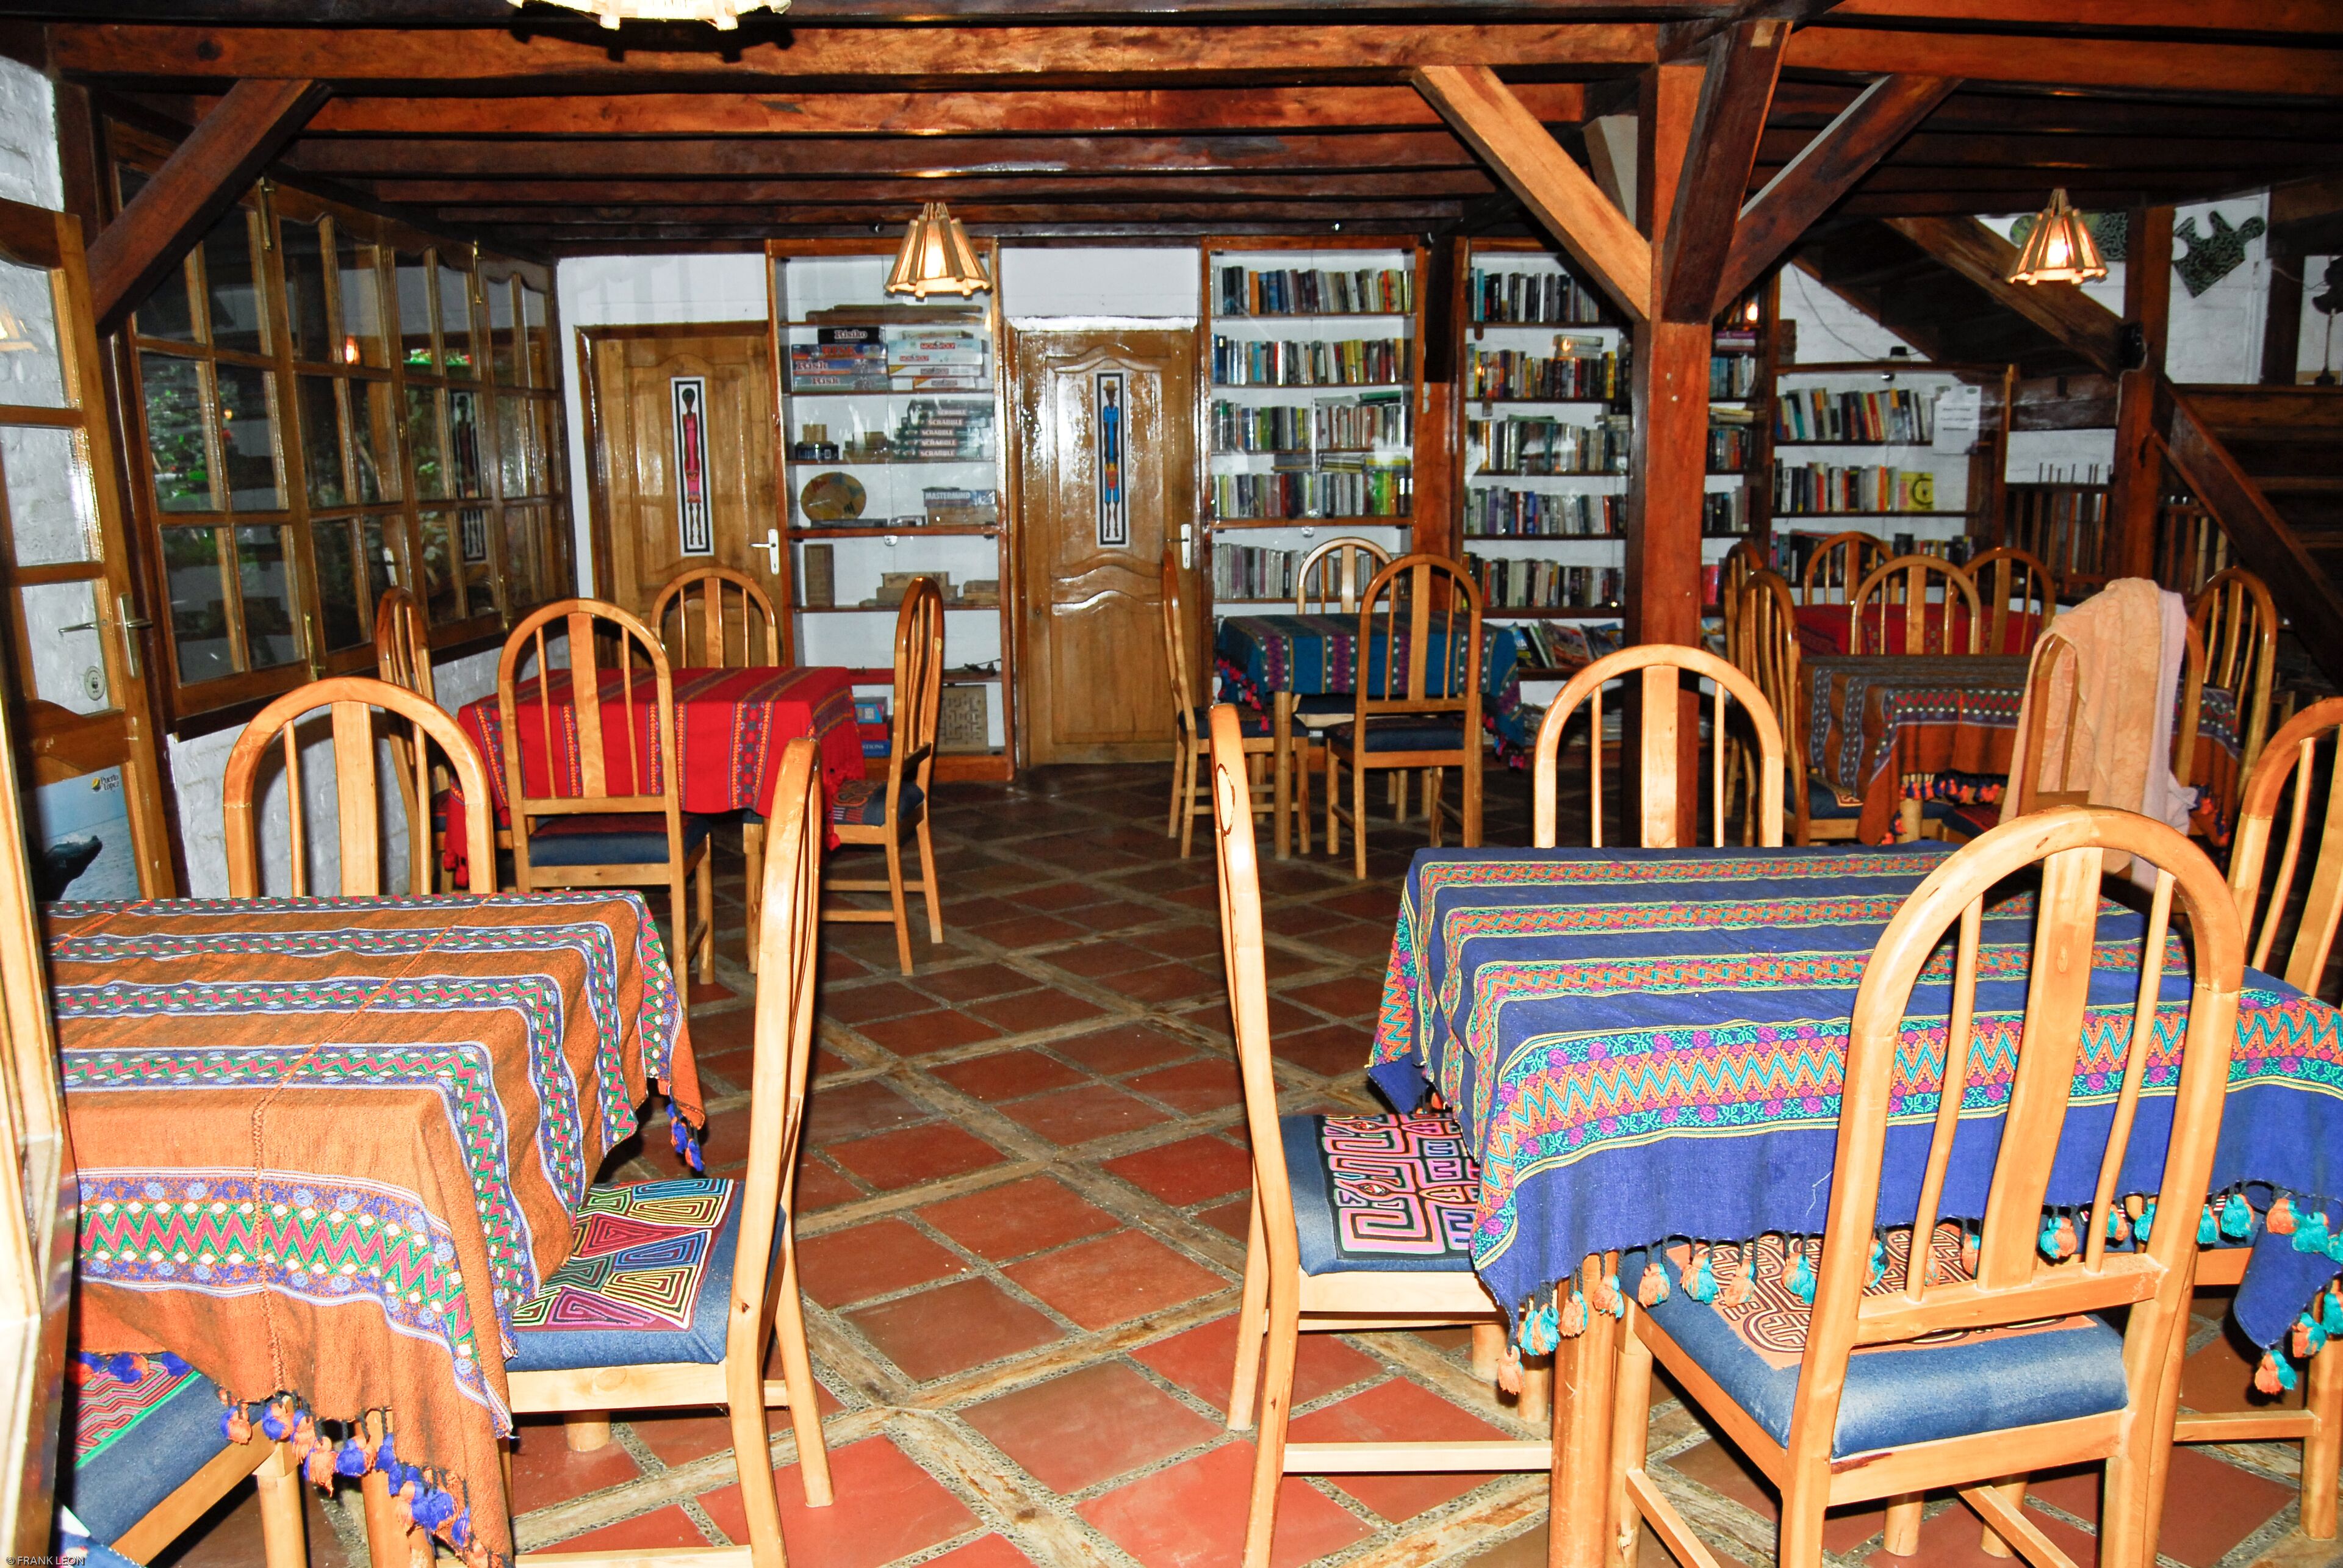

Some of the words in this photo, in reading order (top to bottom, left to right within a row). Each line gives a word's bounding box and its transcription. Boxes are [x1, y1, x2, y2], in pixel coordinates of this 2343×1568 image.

[834, 329, 868, 339] Risiko
[925, 491, 971, 500] MASTERMIND
[101, 774, 119, 785] Puerto
[104, 781, 120, 791] Lopez
